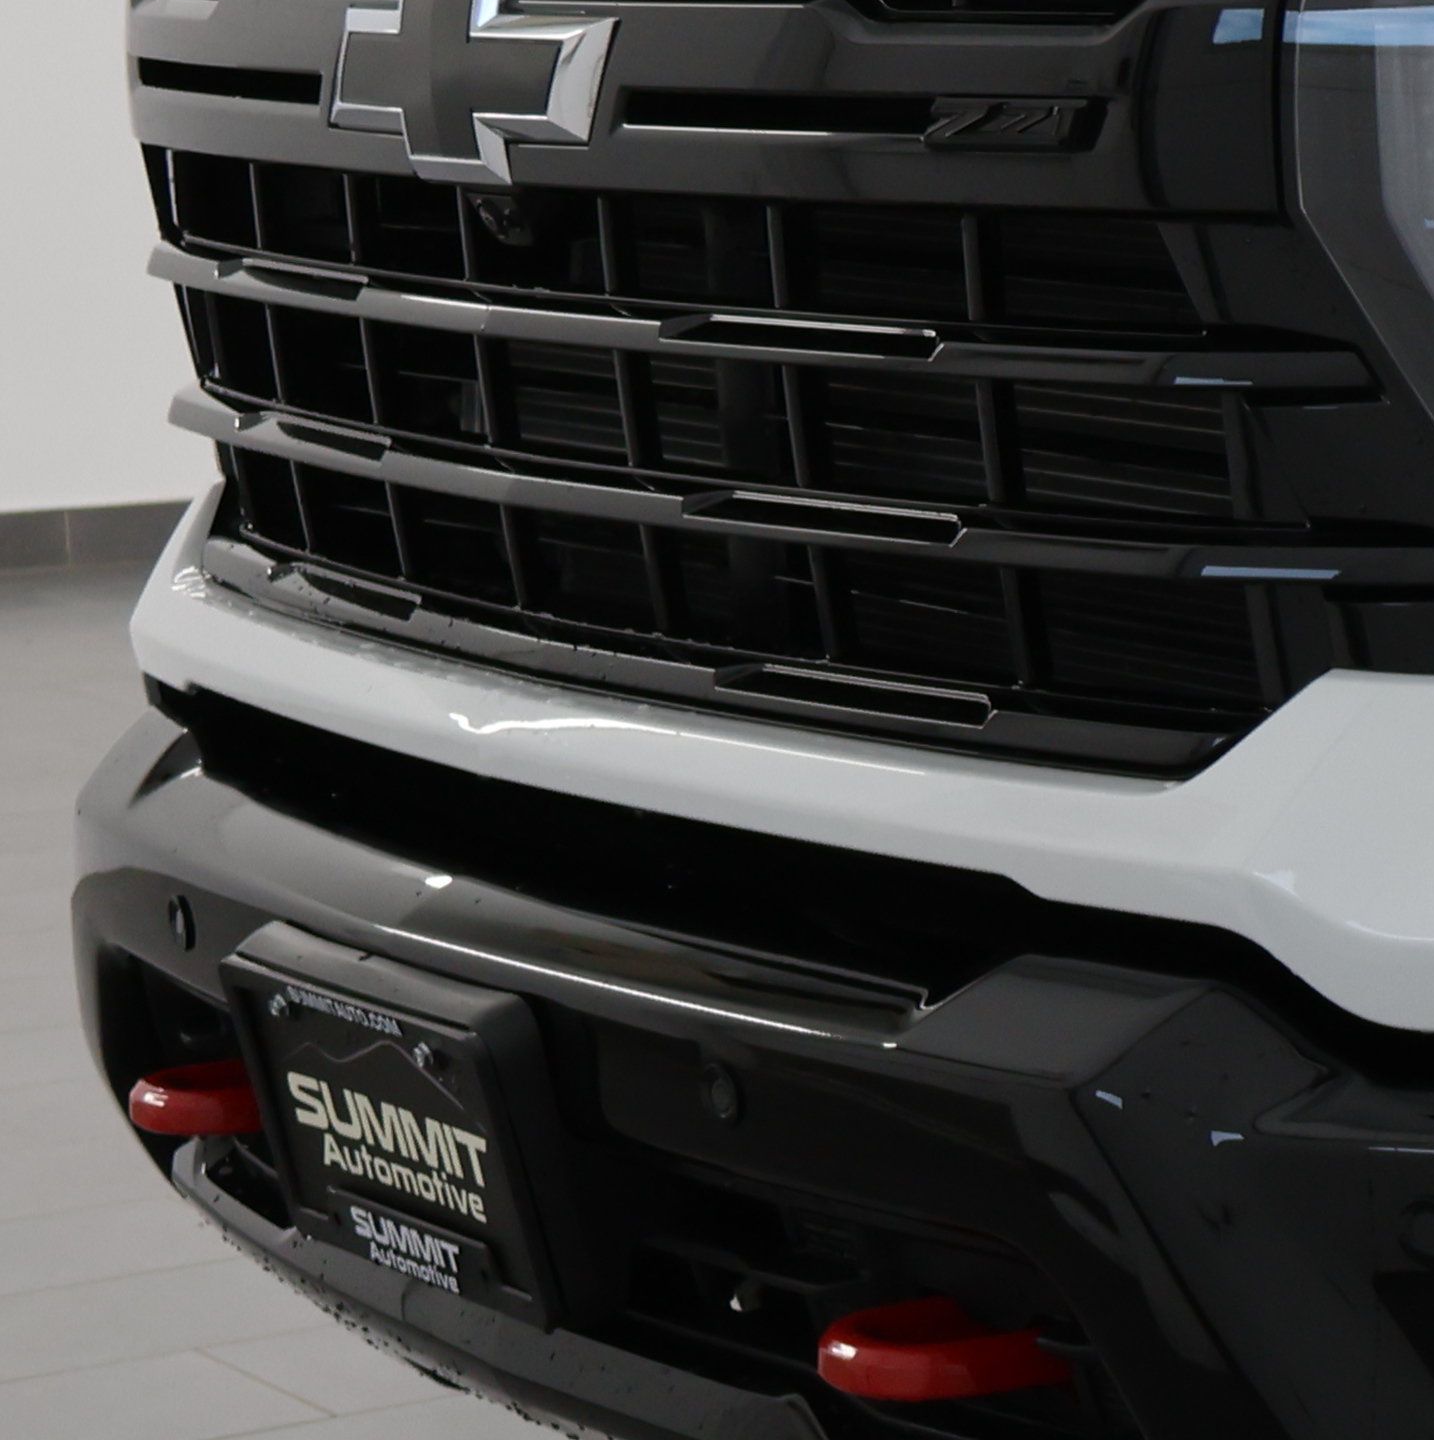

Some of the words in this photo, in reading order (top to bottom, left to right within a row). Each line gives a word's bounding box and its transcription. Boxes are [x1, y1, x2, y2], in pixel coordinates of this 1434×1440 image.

[287, 1071, 487, 1189] SUMMIT
[323, 1133, 487, 1225] Automotive
[350, 1206, 460, 1273] SUMMIT
[369, 1241, 460, 1294] Automotive
